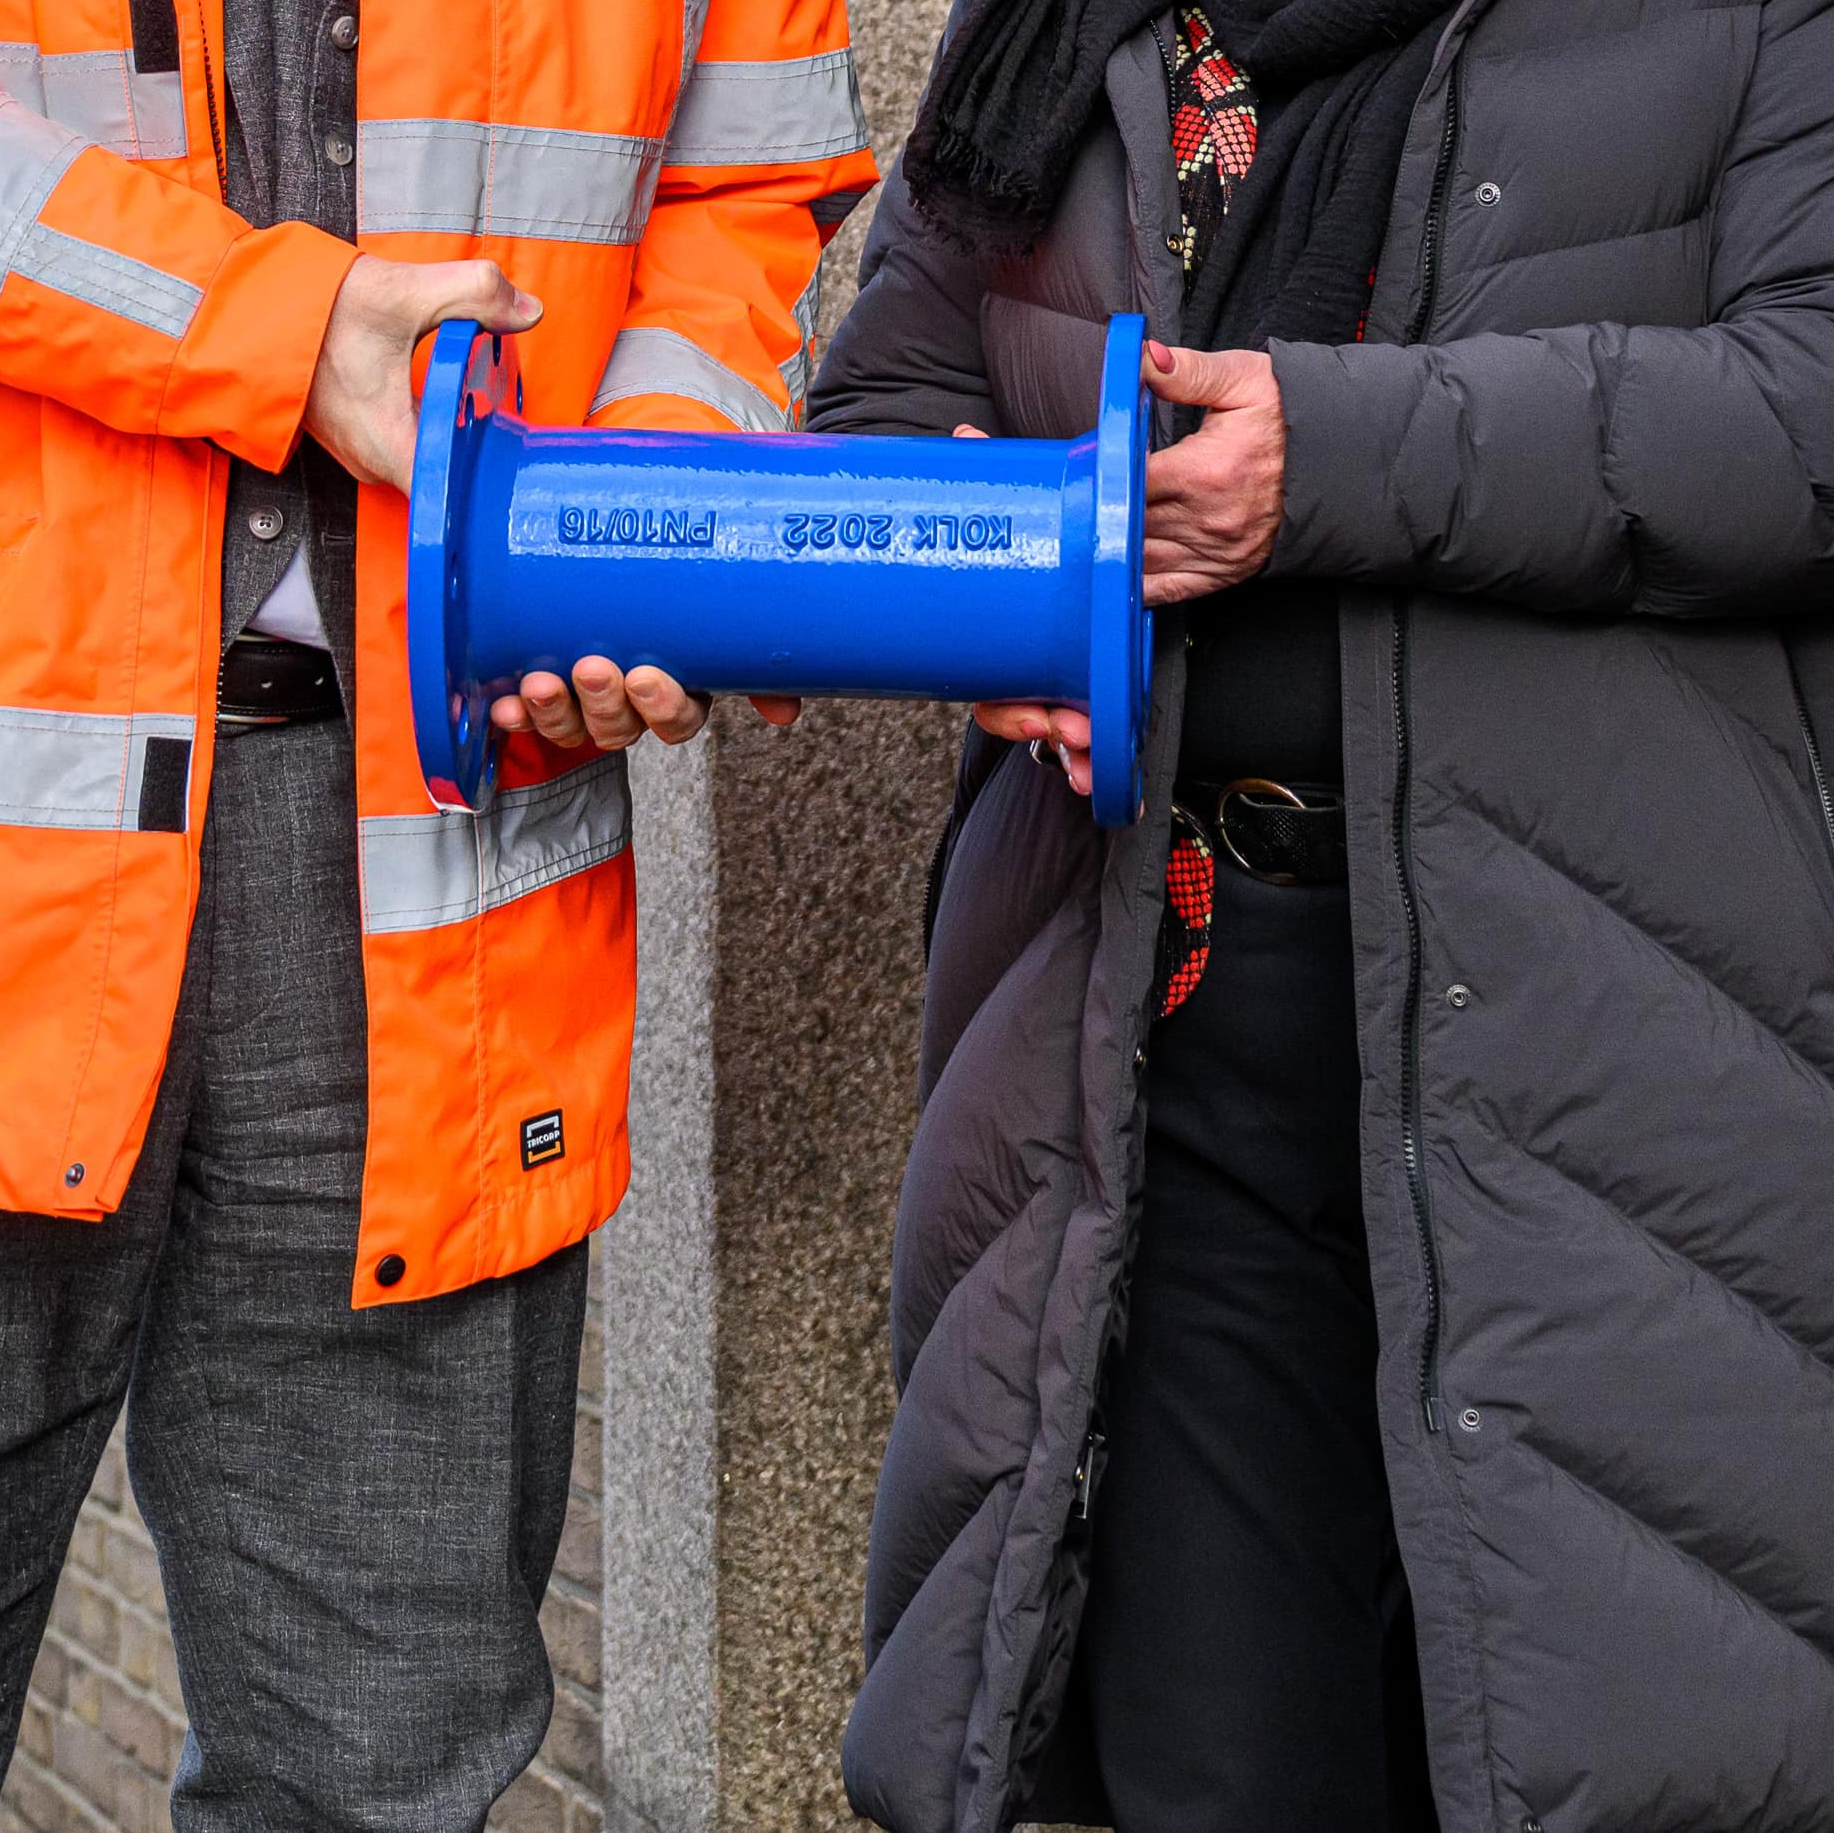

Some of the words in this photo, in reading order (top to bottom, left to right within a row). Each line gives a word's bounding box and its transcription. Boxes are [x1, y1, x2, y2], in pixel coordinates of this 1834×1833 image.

[558, 506, 717, 547] PN10/16
[782, 512, 893, 552] 2022
[913, 514, 1013, 551] KOLK
[526, 1130, 560, 1149] TRICORP
